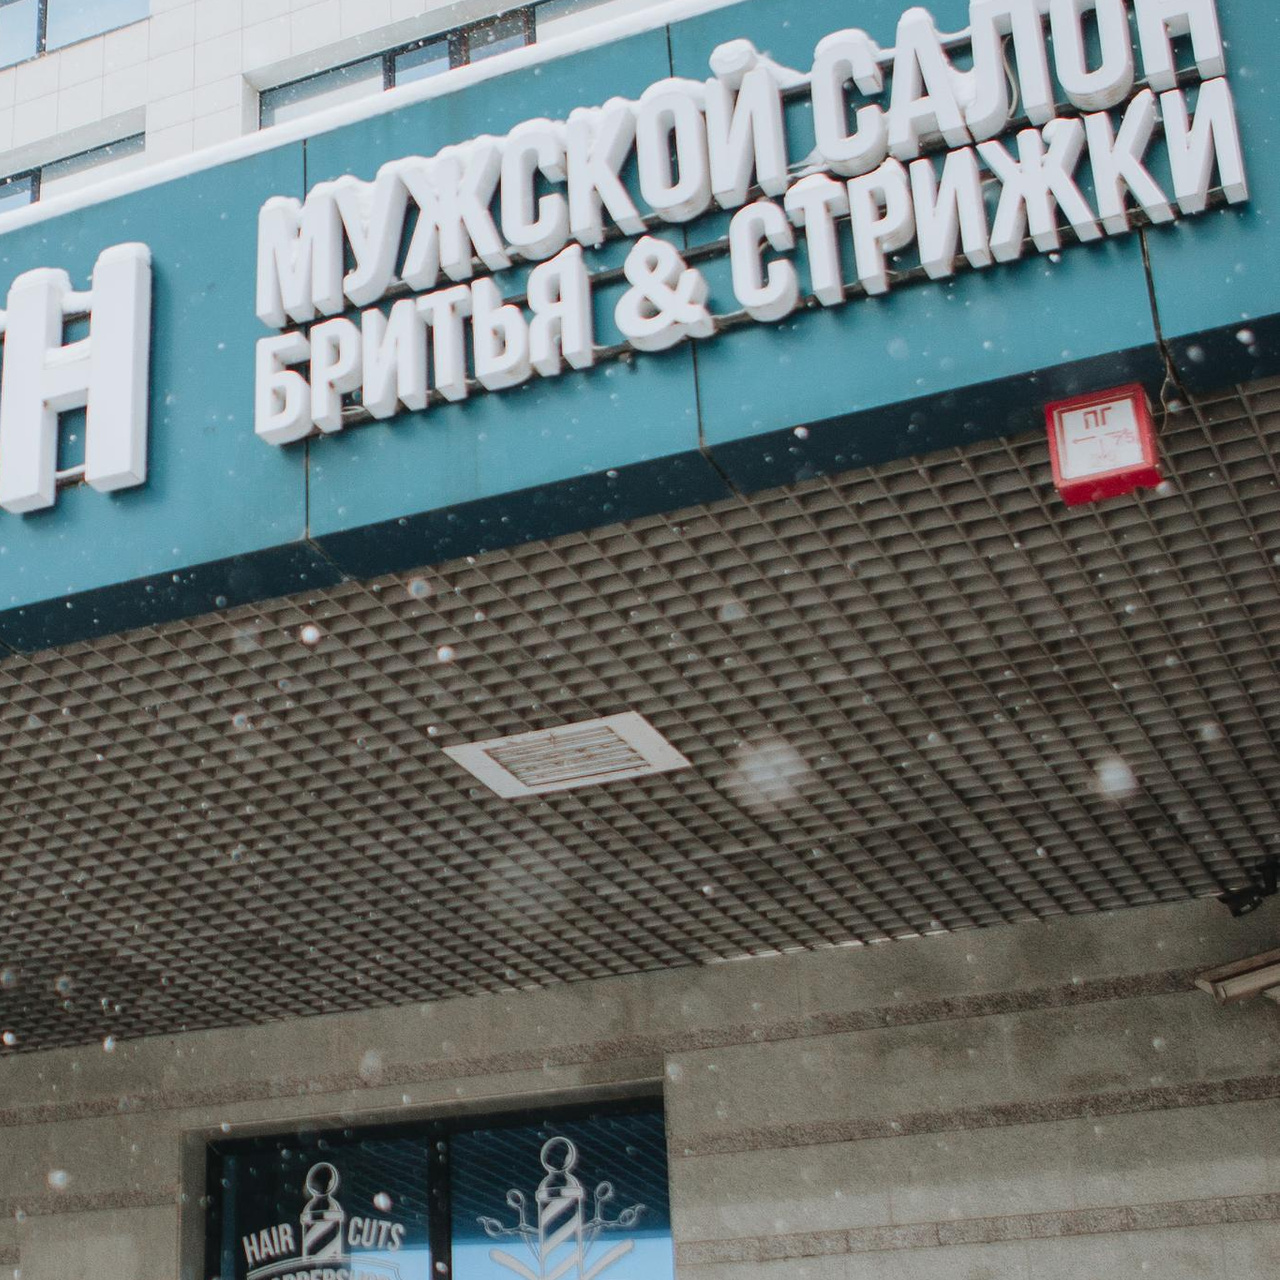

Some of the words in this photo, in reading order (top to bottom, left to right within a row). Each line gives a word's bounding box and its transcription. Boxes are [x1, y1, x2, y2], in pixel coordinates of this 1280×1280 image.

[255, 242, 594, 446] БРИТЬЯ
[615, 235, 715, 352] &
[729, 76, 1248, 321] СТРИЖКИ
[256, 39, 789, 327] МУЖСКОЙ
[1083, 406, 1112, 430] ПГ
[242, 1222, 296, 1268] HAIR
[347, 1216, 407, 1252] CUTS
